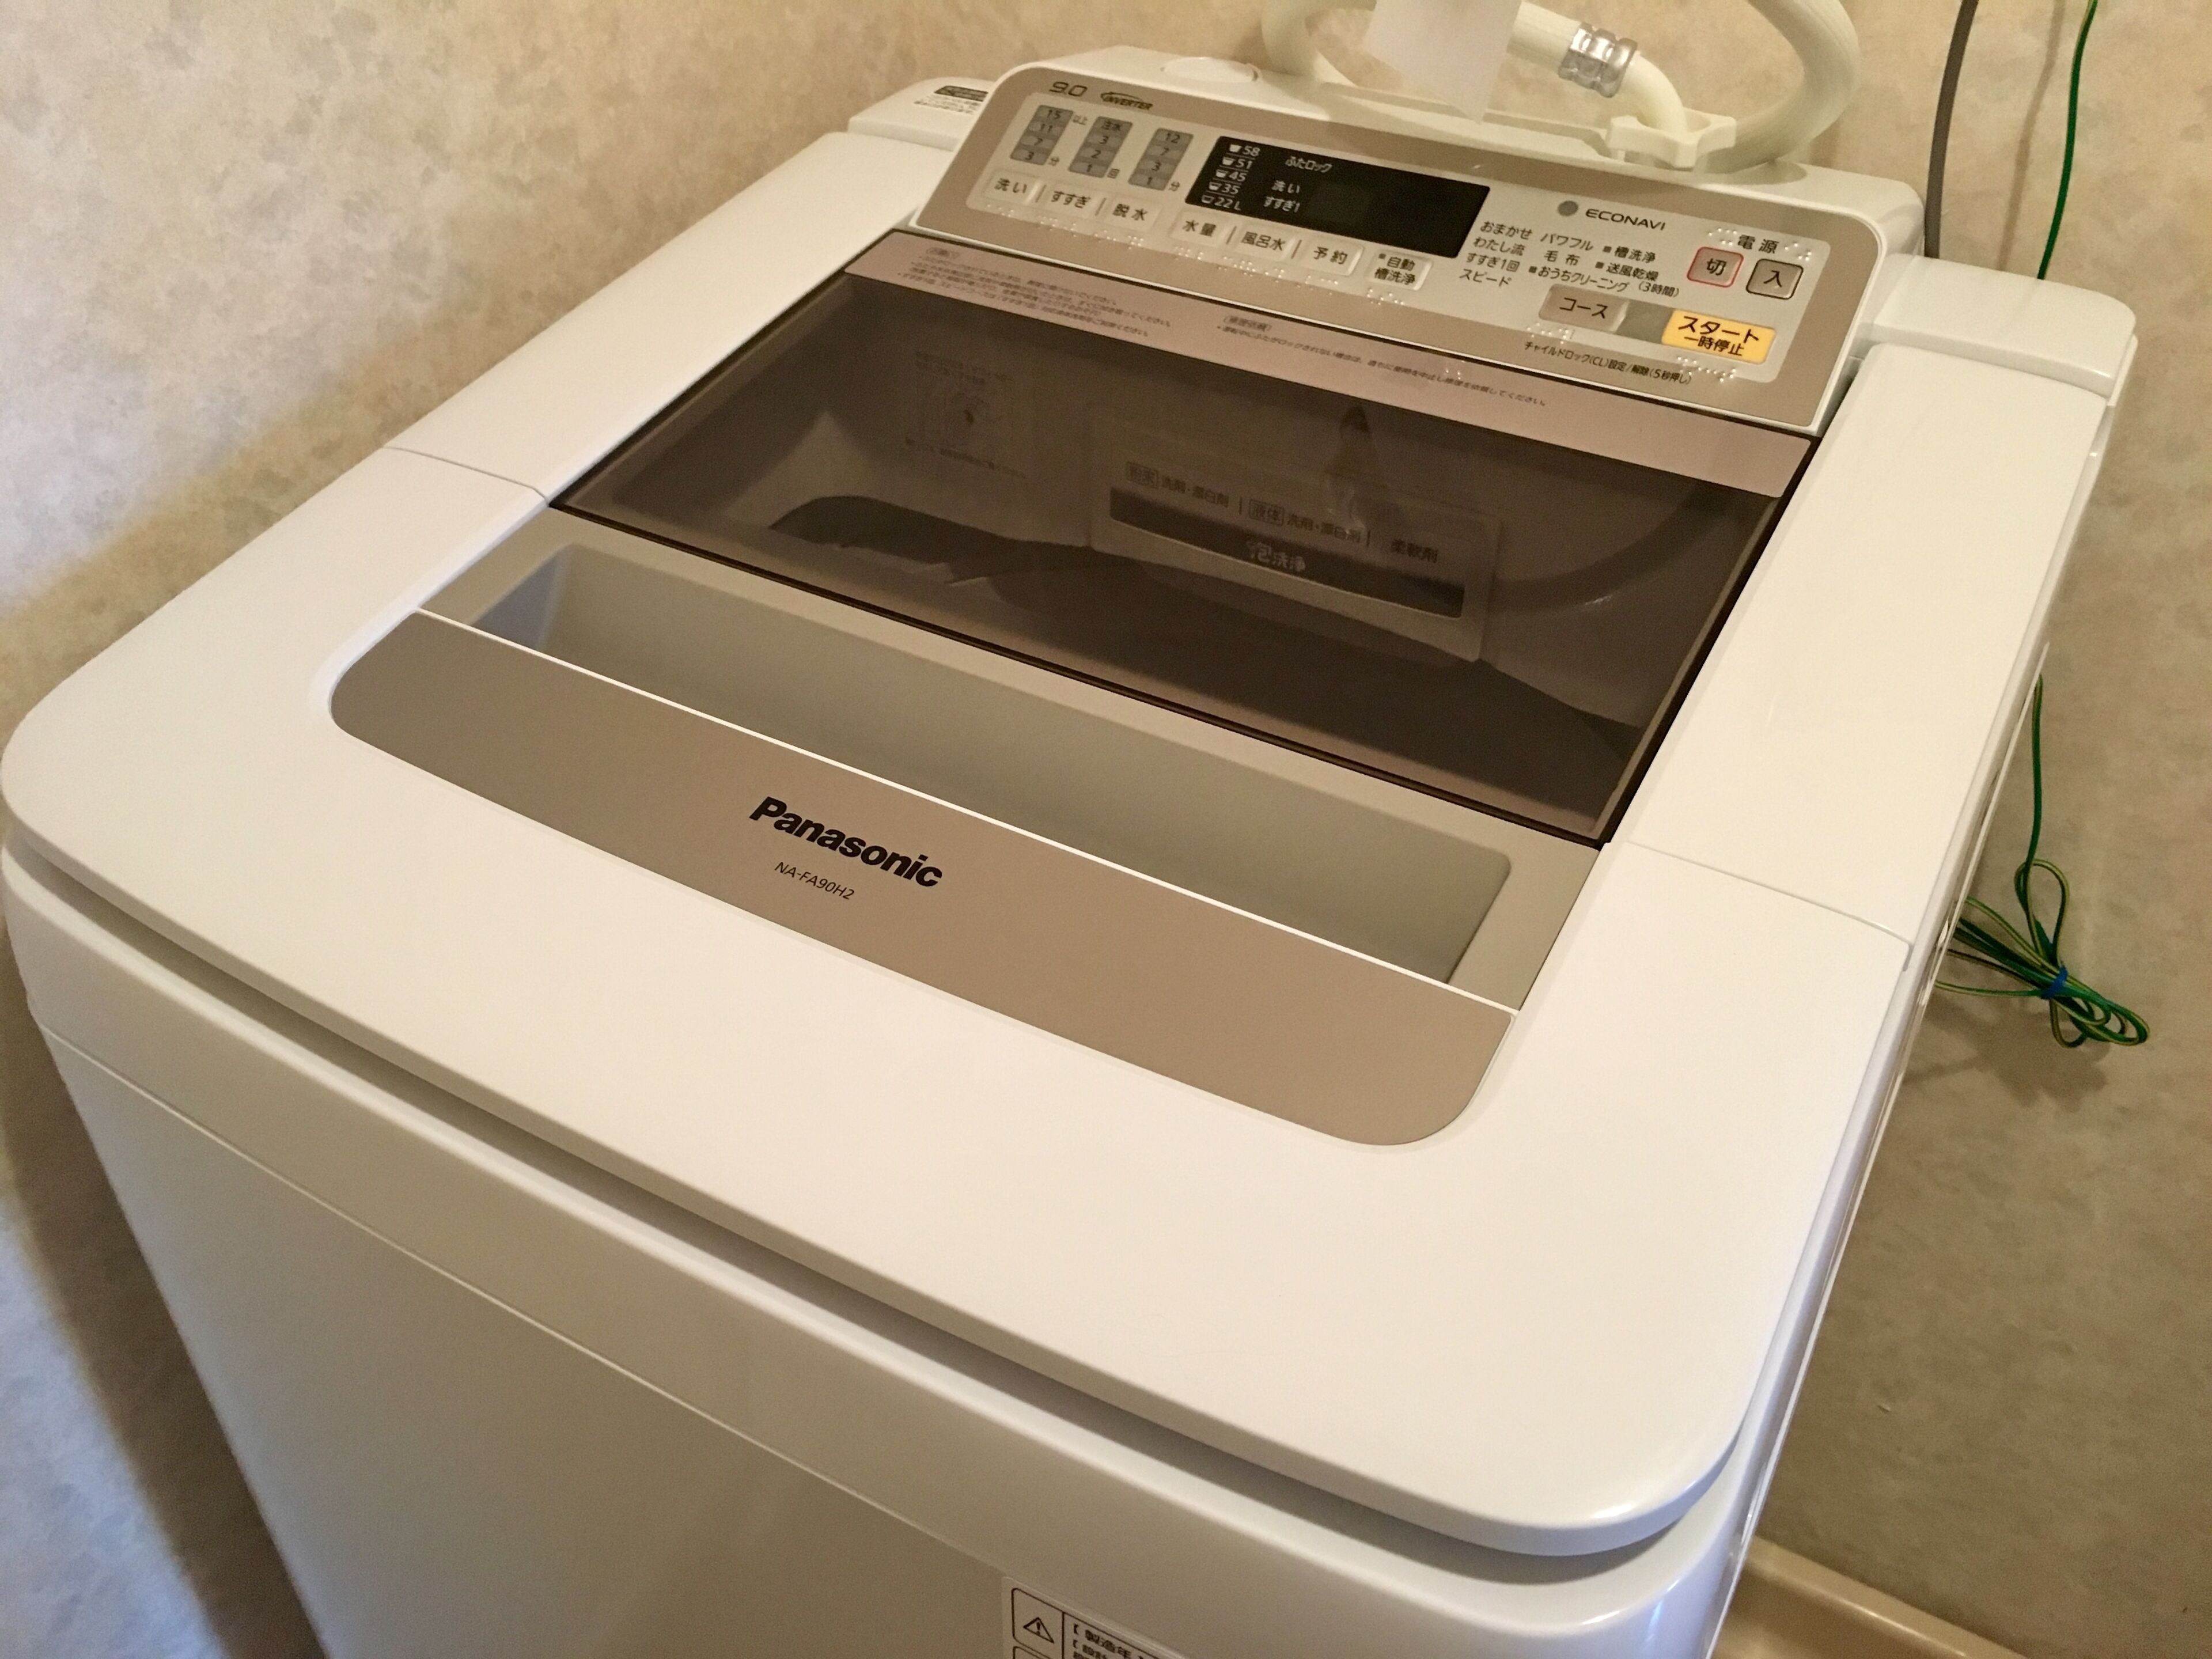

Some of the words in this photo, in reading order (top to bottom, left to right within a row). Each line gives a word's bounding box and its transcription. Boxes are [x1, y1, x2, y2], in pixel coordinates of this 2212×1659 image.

[1047, 109, 1061, 120] 15
[1040, 123, 1053, 133] 11
[1033, 138, 1043, 146] 7
[1100, 135, 1109, 145] 3
[1165, 132, 1181, 143] 12
[1024, 151, 1035, 161] 3
[1090, 150, 1101, 159] 2
[1160, 147, 1169, 157] 7
[1242, 145, 1261, 157] 58
[1086, 164, 1093, 173] 1
[1152, 162, 1162, 172] 3
[1235, 158, 1253, 169] 51
[1285, 156, 1334, 173] ふたロック
[1147, 176, 1153, 185] 1
[1229, 170, 1247, 182] 45
[994, 178, 1028, 194] 洗い
[1222, 183, 1239, 195] 35
[1271, 179, 1301, 194] 洗い
[1051, 190, 1092, 209] すすぎ
[1263, 196, 1301, 213] すすぎ1
[1112, 203, 1148, 221] 脱水
[1585, 208, 1666, 231] ECONAVI
[1181, 219, 1217, 237] 水量
[1480, 220, 1533, 240] おまかせ
[1241, 231, 1286, 251] 風呂水
[1473, 236, 1526, 256] わたし流
[1540, 233, 1594, 251] パワフル
[1737, 234, 1779, 253] 電源
[1313, 246, 1349, 265] 予約
[1466, 252, 1521, 272] すすぎ1回
[1544, 249, 1581, 266] 毛布
[1614, 245, 1657, 264] 槽洗浄
[1387, 256, 1416, 271] 自動
[1606, 262, 1660, 282] 送風乾燥
[1706, 257, 1727, 276] 切
[1374, 267, 1417, 286] 槽洗浄
[1459, 268, 1512, 288] スピード
[1538, 266, 1630, 293] おうちクリーニング
[1763, 270, 1782, 287] 入
[1559, 297, 1608, 319] コース
[1677, 315, 1760, 343] スタート
[1684, 335, 1746, 357] 一時停止
[749, 796, 943, 887] Panasonic
[774, 861, 855, 900] NA-FA90H2
